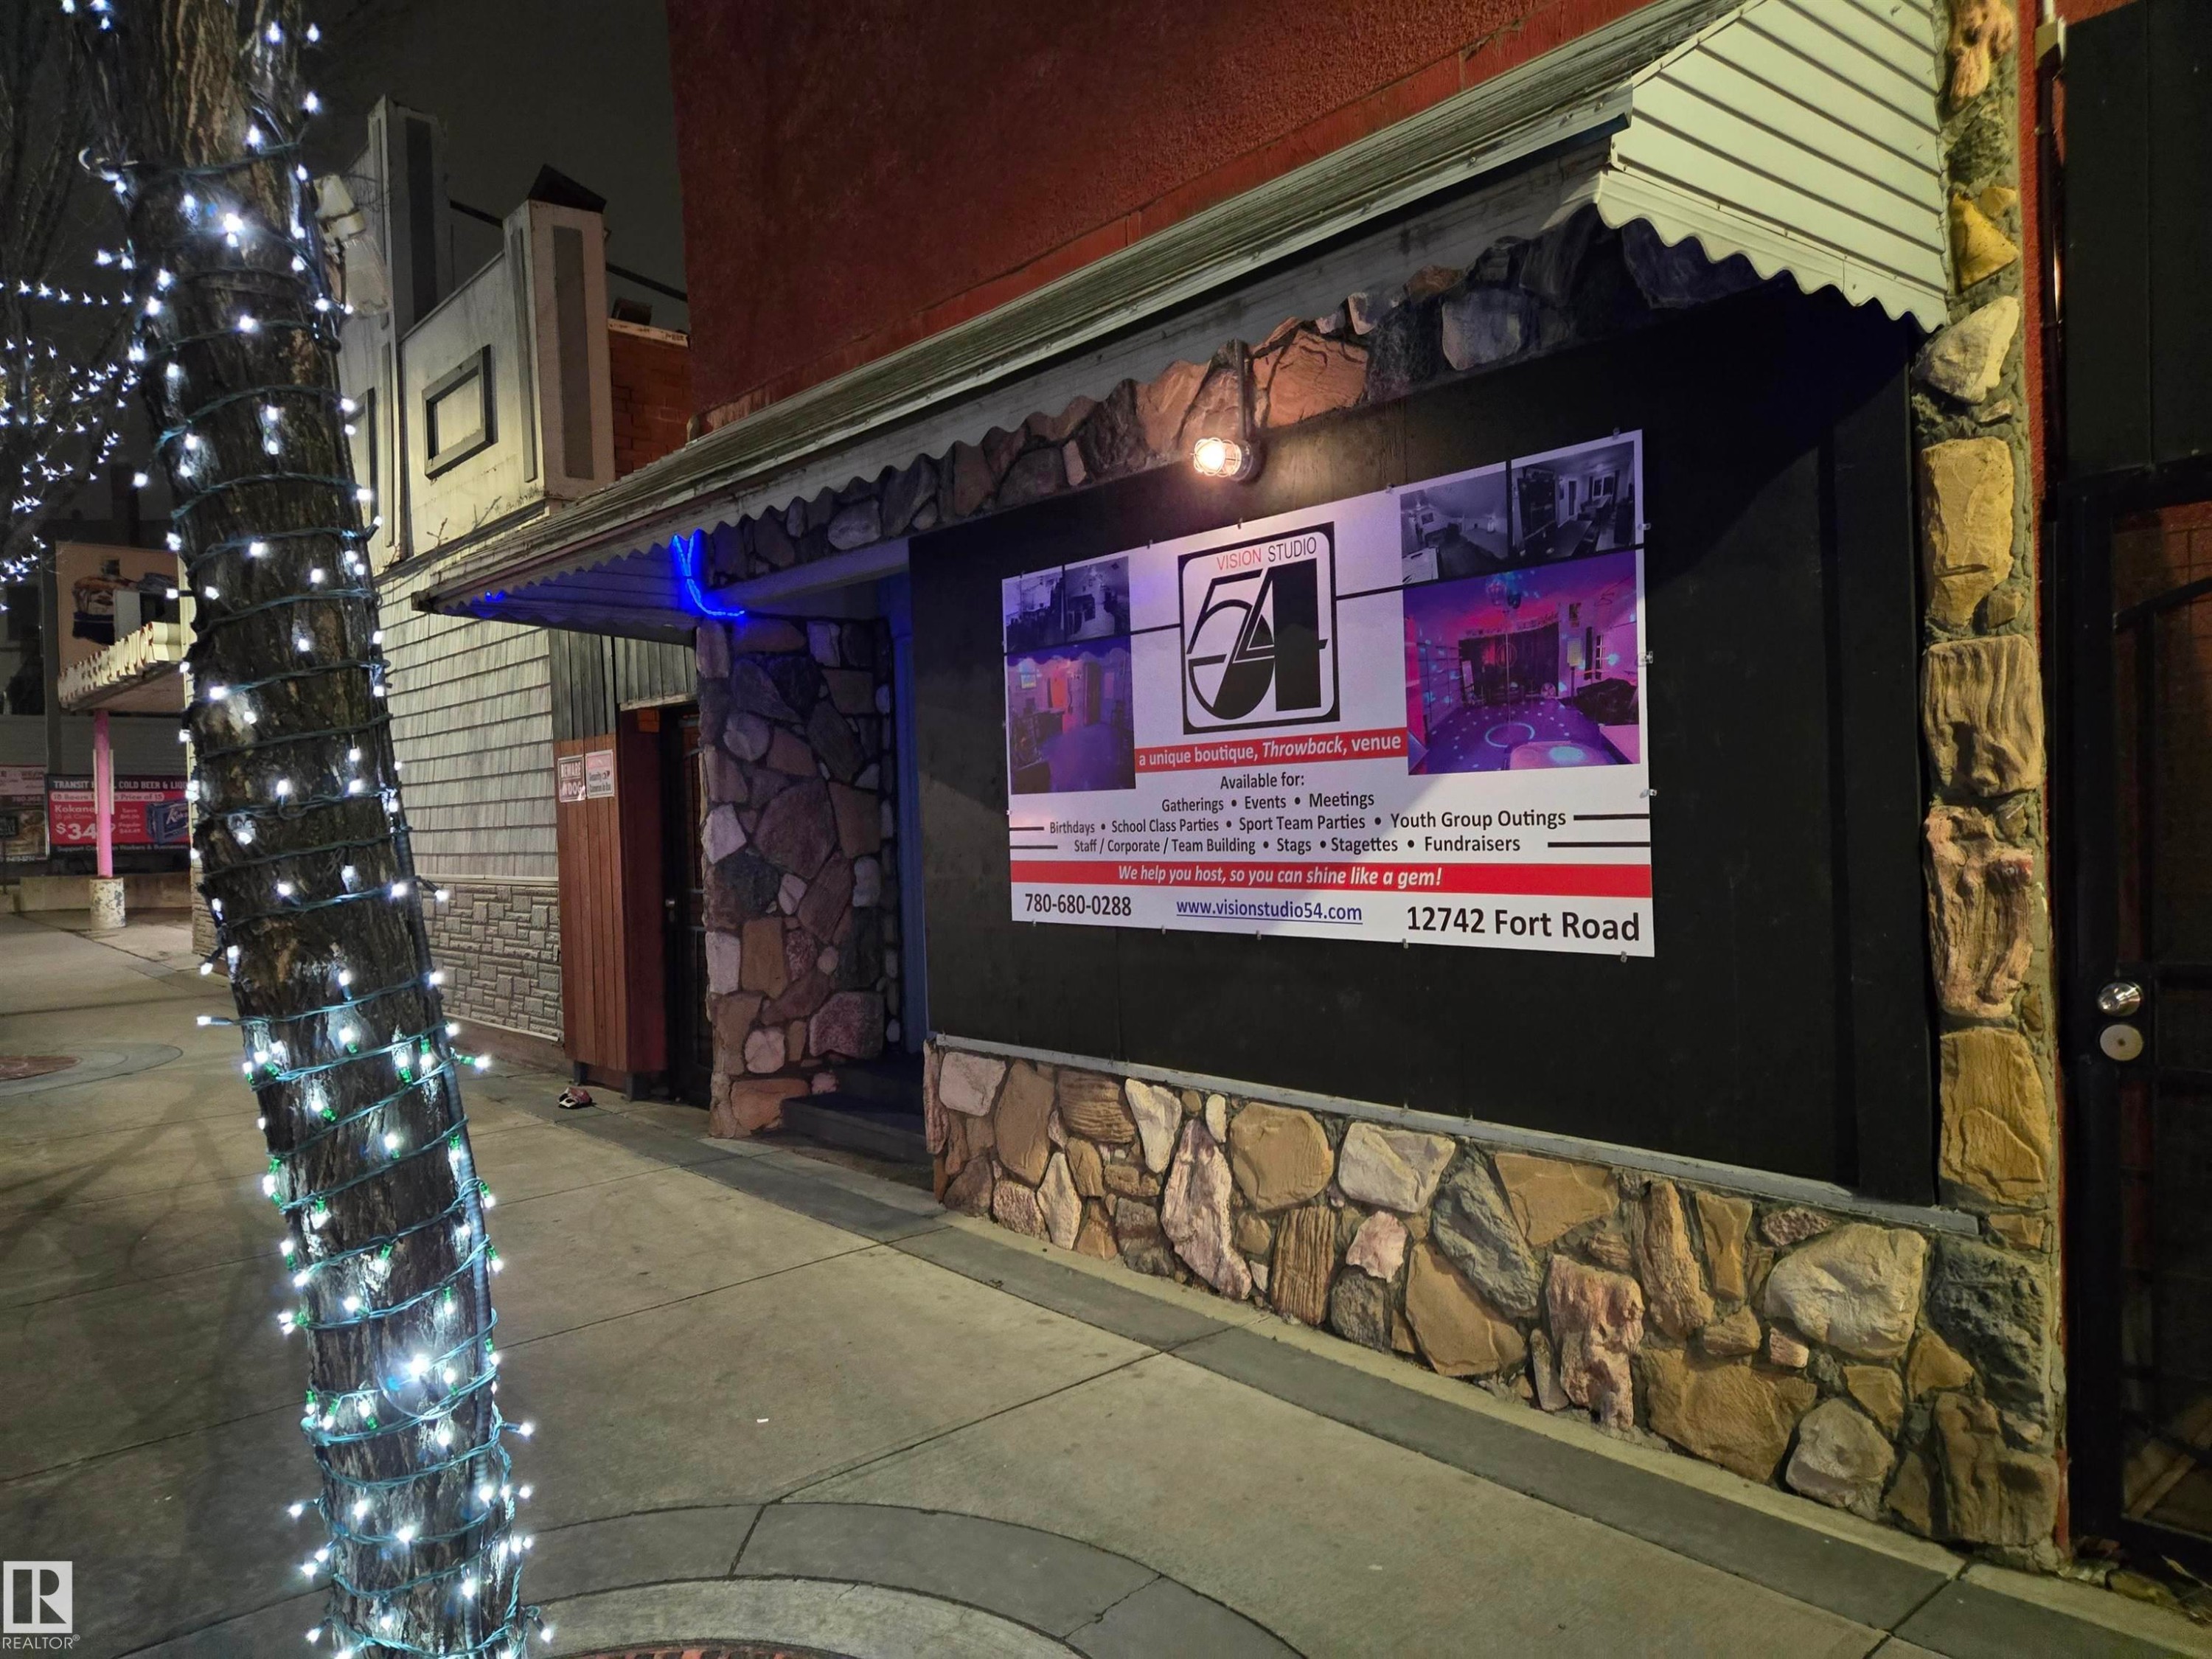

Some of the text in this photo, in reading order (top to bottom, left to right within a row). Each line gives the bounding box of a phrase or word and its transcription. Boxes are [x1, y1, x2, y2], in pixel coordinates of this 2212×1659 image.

[1217, 536, 1317, 571] VISION STUDIO
[1186, 558, 1329, 720] 54
[1139, 735, 1402, 768] a unique boutique, Throwback, venue
[560, 761, 581, 779] BEWARE
[1220, 772, 1305, 790] Available for:
[54, 780, 89, 789] TRANSIT
[119, 781, 139, 789] COLD
[141, 781, 161, 789] BEER
[55, 804, 96, 813] Kokane
[1161, 792, 1375, 814] Gatherings Events Meetings
[1050, 809, 1567, 835] Birthdays School Class Parties Sport Team Parties Youth Group Outings
[1074, 835, 1521, 855] Staff / Corporate / Team Building Stags Stagettes Fundraisers
[1119, 865, 1443, 889] We help you host, so you can shine like a gem!
[1024, 893, 1132, 916] 780-680-0288
[1176, 899, 1363, 922] www.visionstudio54.com
[1407, 905, 1641, 941] 12742 Fort Road
